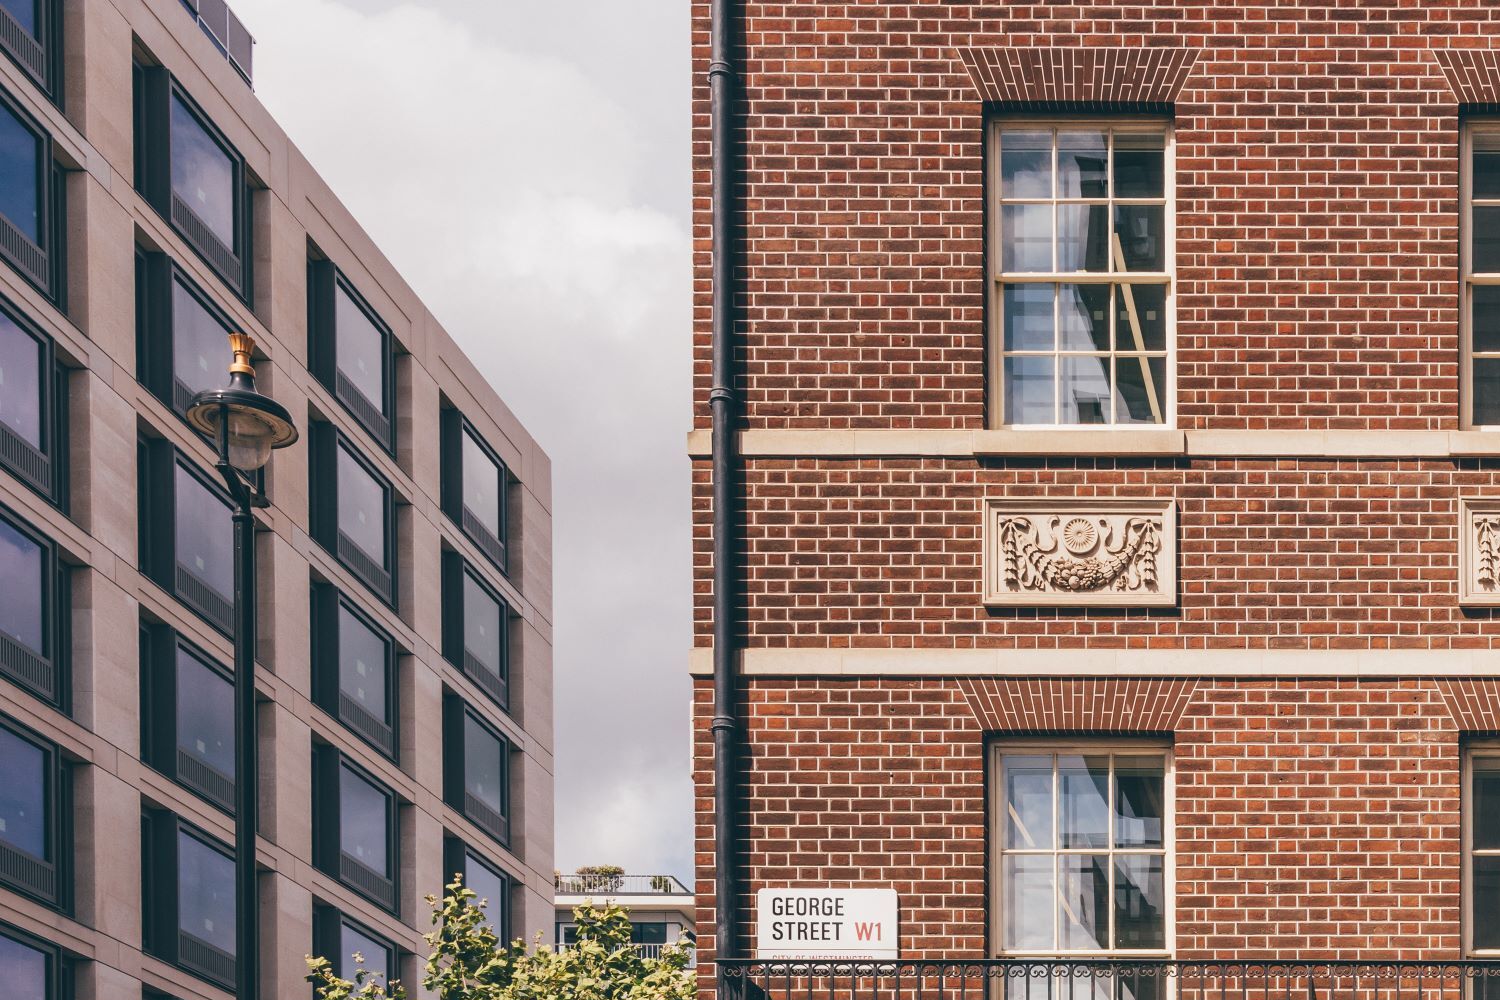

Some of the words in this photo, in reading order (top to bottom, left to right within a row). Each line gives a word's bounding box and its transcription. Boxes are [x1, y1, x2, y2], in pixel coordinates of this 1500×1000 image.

[772, 897, 844, 916] GEORGE
[772, 921, 844, 941] STREET
[855, 922, 881, 941] W1
